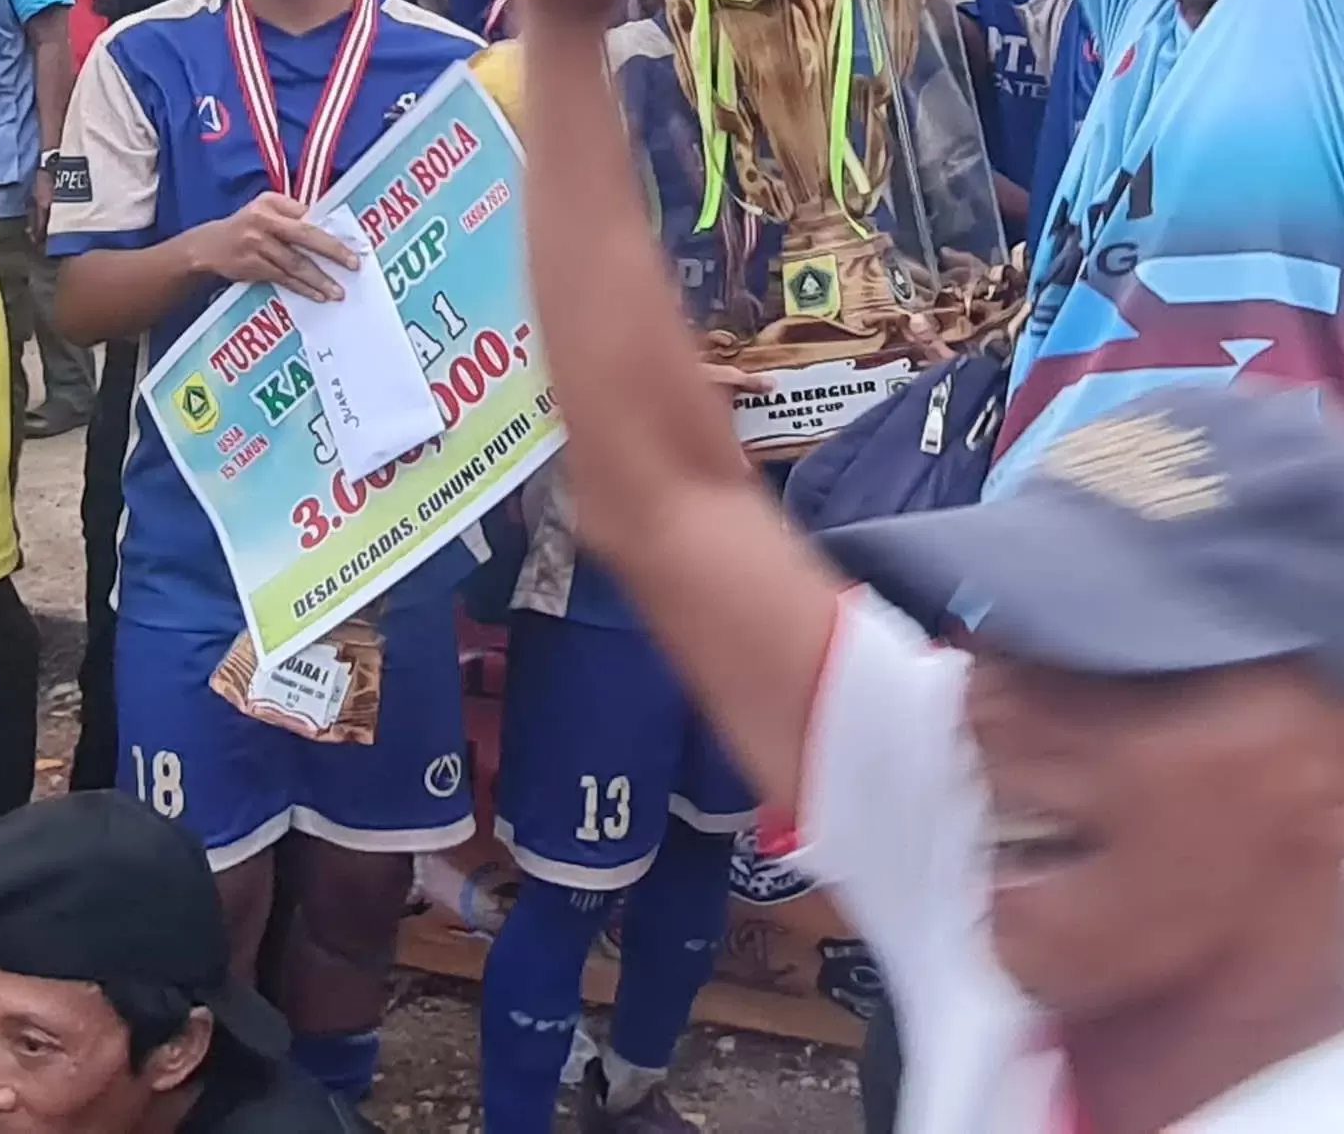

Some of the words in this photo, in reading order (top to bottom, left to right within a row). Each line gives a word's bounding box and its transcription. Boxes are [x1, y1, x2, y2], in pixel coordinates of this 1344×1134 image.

[409, 121, 479, 197] BOLA
[383, 219, 446, 301] CUP
[732, 391, 787, 412] PIALA
[816, 402, 844, 413] CUP
[290, 575, 340, 619] DESA
[413, 456, 487, 522] GUNUNG
[482, 412, 533, 465] PUTRI
[131, 745, 185, 819] 18
[574, 775, 632, 842] 13
